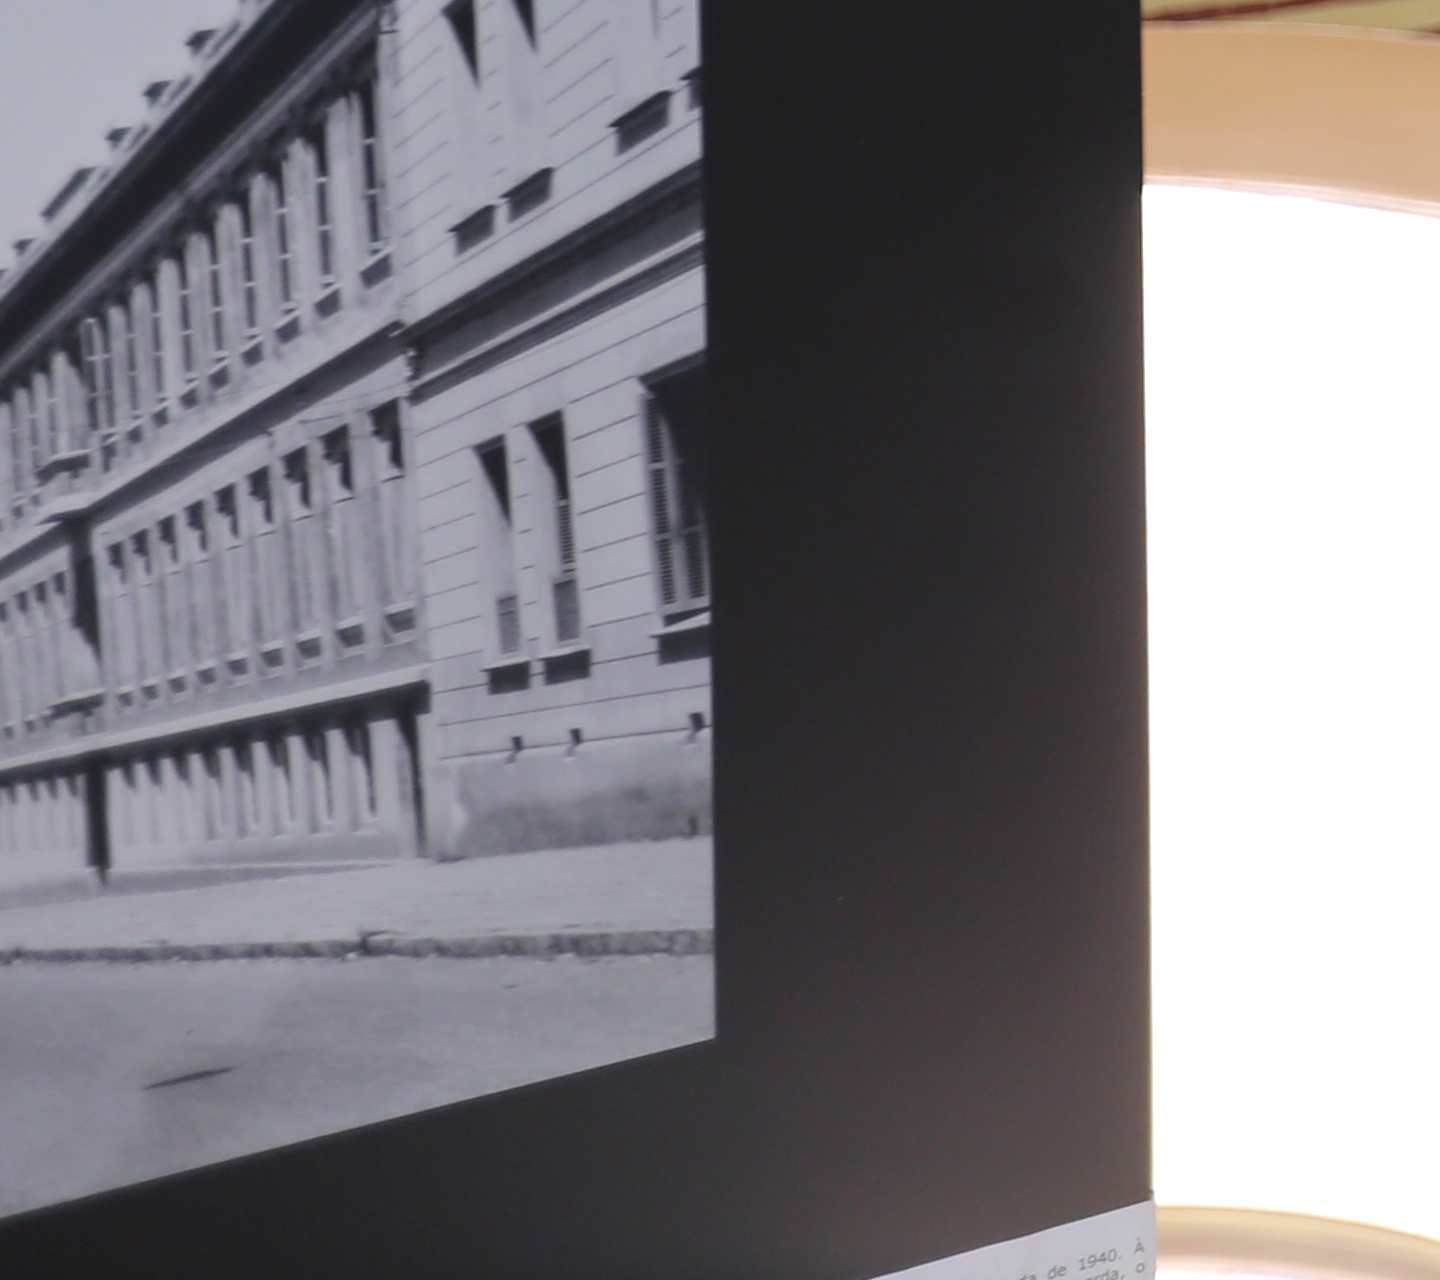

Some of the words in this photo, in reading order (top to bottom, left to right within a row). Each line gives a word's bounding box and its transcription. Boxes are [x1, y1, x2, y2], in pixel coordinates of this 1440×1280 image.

[1048, 1264, 1067, 1280] de
[1078, 1248, 1122, 1272] 1940.
[1135, 1262, 1146, 1274] o
